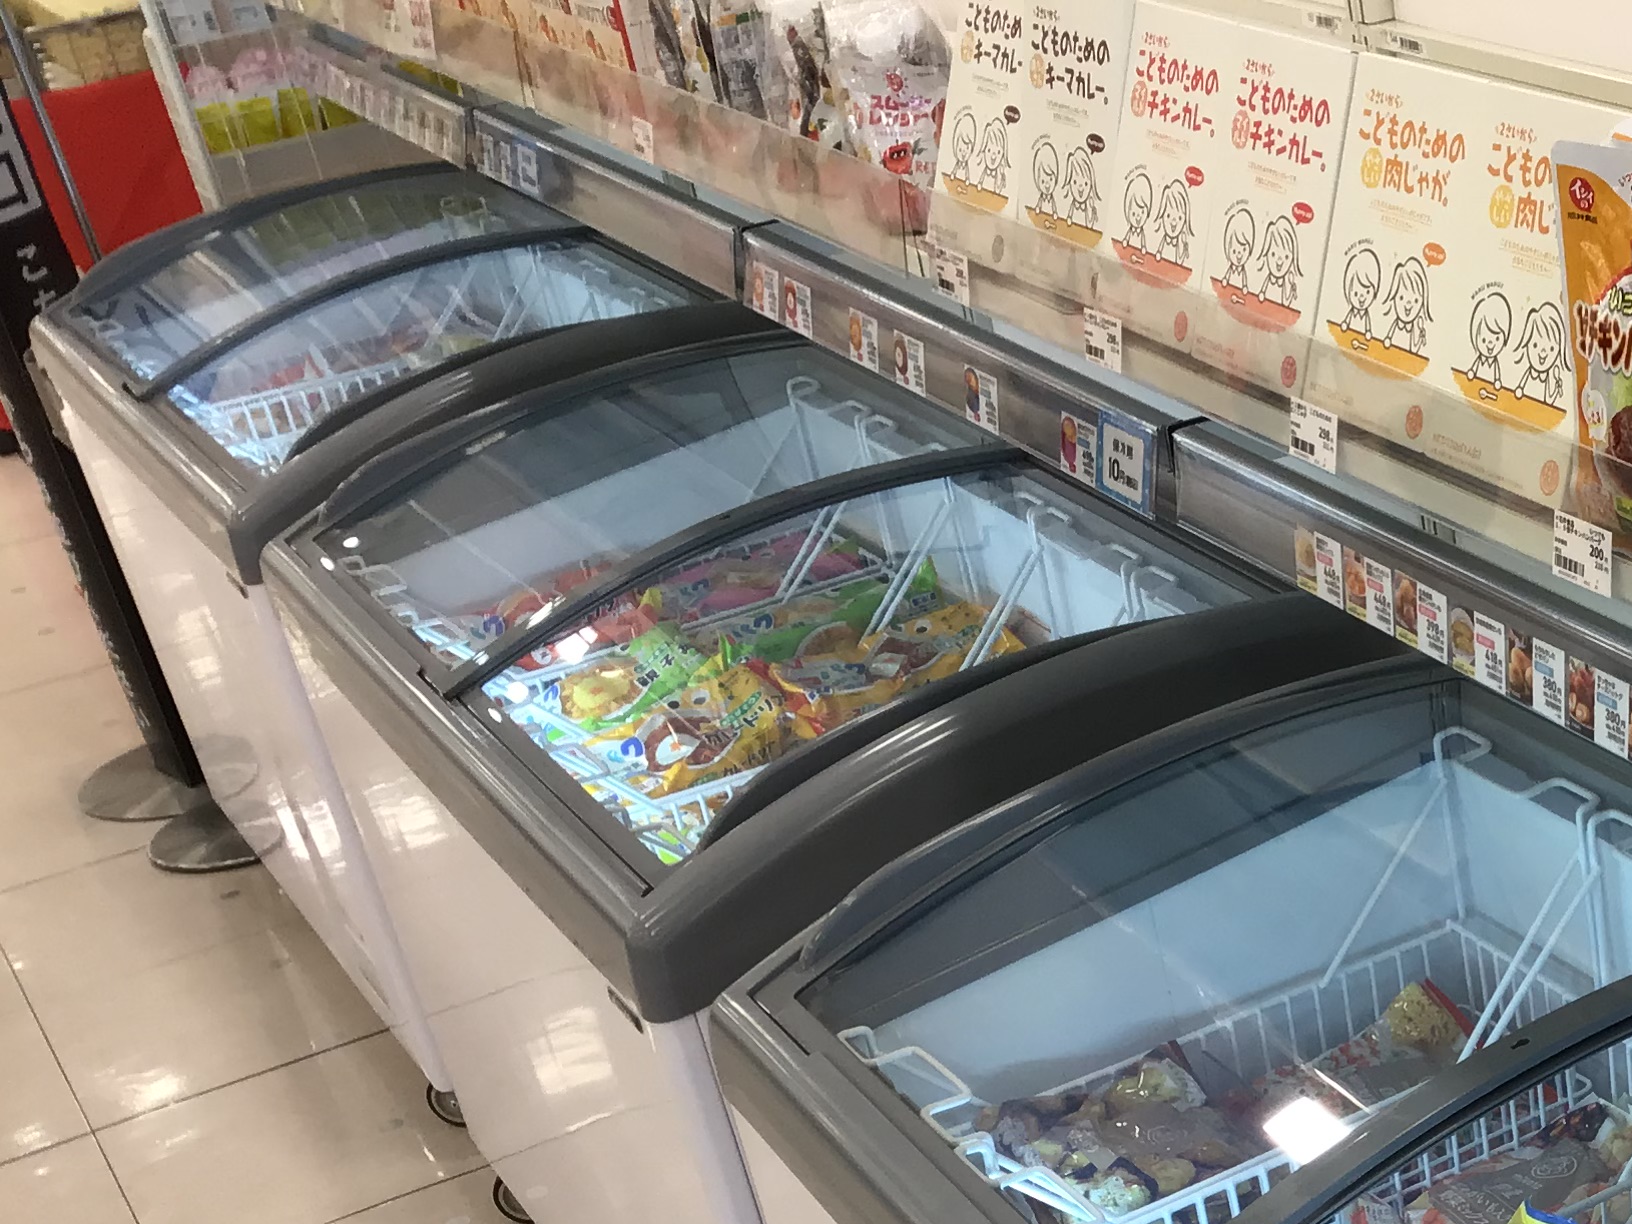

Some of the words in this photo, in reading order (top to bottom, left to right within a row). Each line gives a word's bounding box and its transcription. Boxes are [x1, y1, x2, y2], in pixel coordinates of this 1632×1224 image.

[1031, 23, 1110, 66] こどものための
[1136, 50, 1219, 95] こどものための
[1237, 77, 1330, 127] こどものための
[1359, 109, 1465, 163] こどものための
